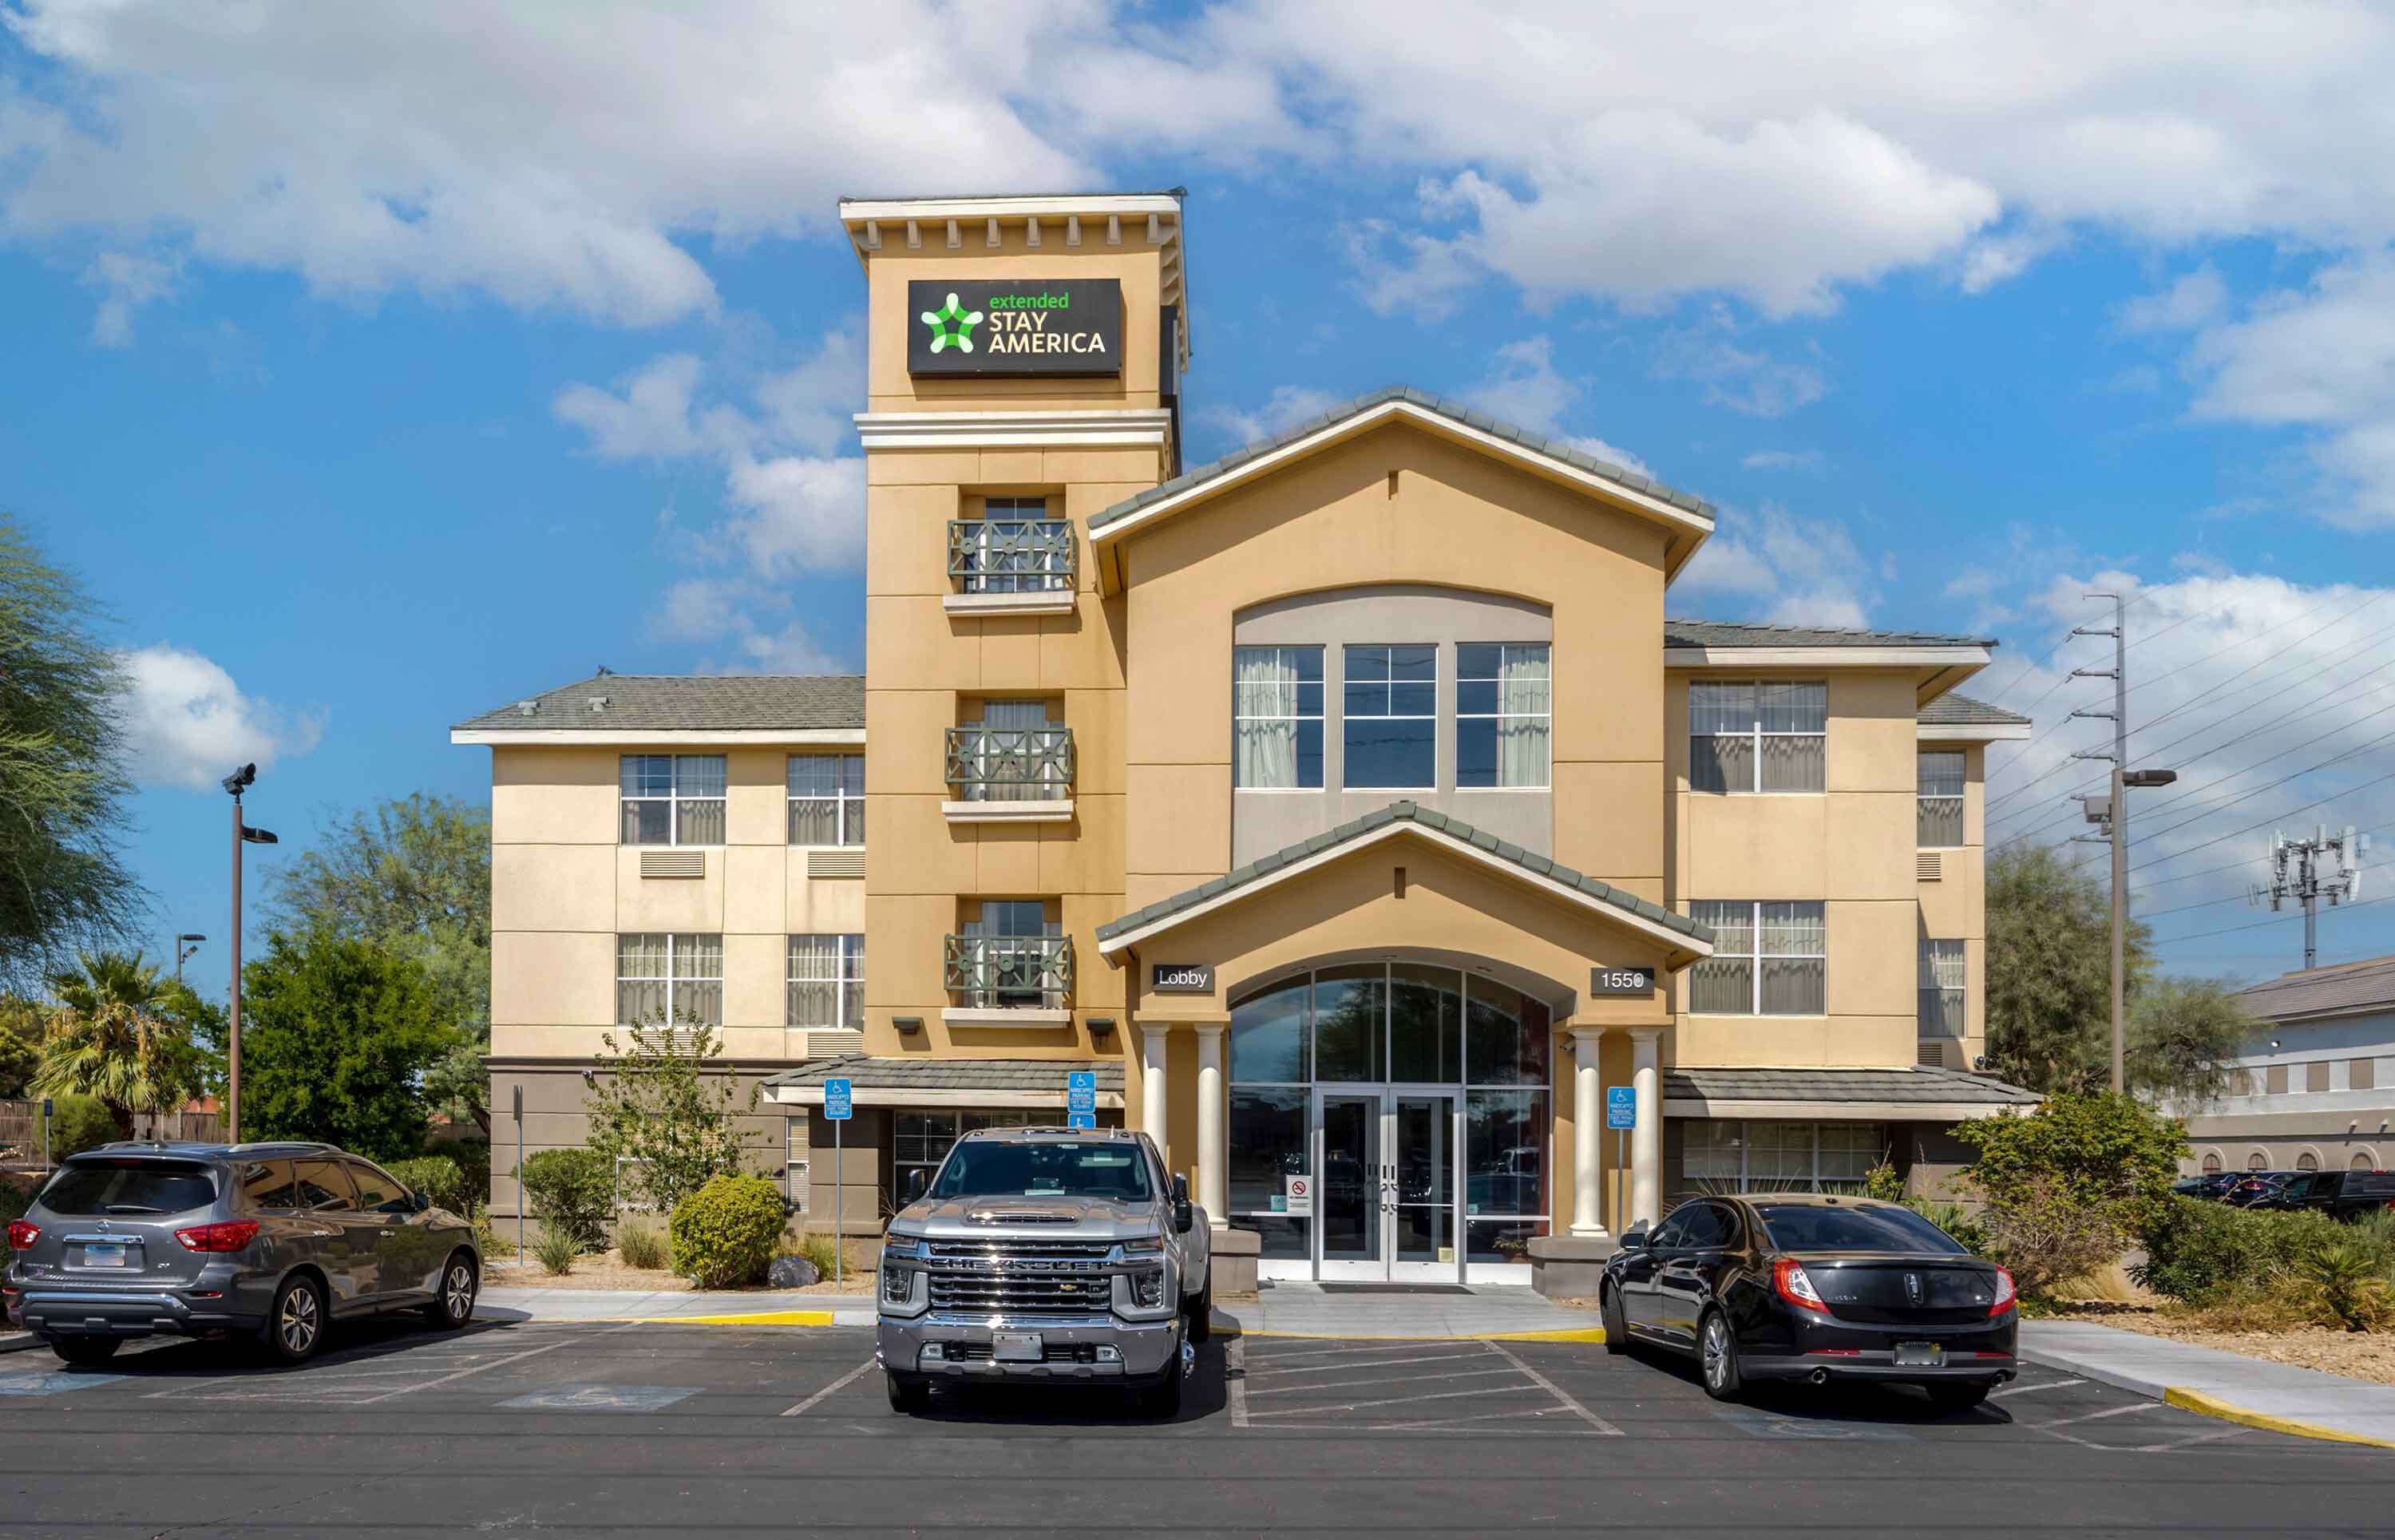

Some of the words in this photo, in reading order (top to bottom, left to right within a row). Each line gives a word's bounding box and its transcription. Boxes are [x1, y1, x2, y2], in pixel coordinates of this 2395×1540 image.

[989, 292, 1070, 309] extended
[989, 311, 1048, 332] STAY
[988, 332, 1106, 354] AMERICA
[1158, 970, 1208, 988] Lobby
[1601, 972, 1645, 988] 1550
